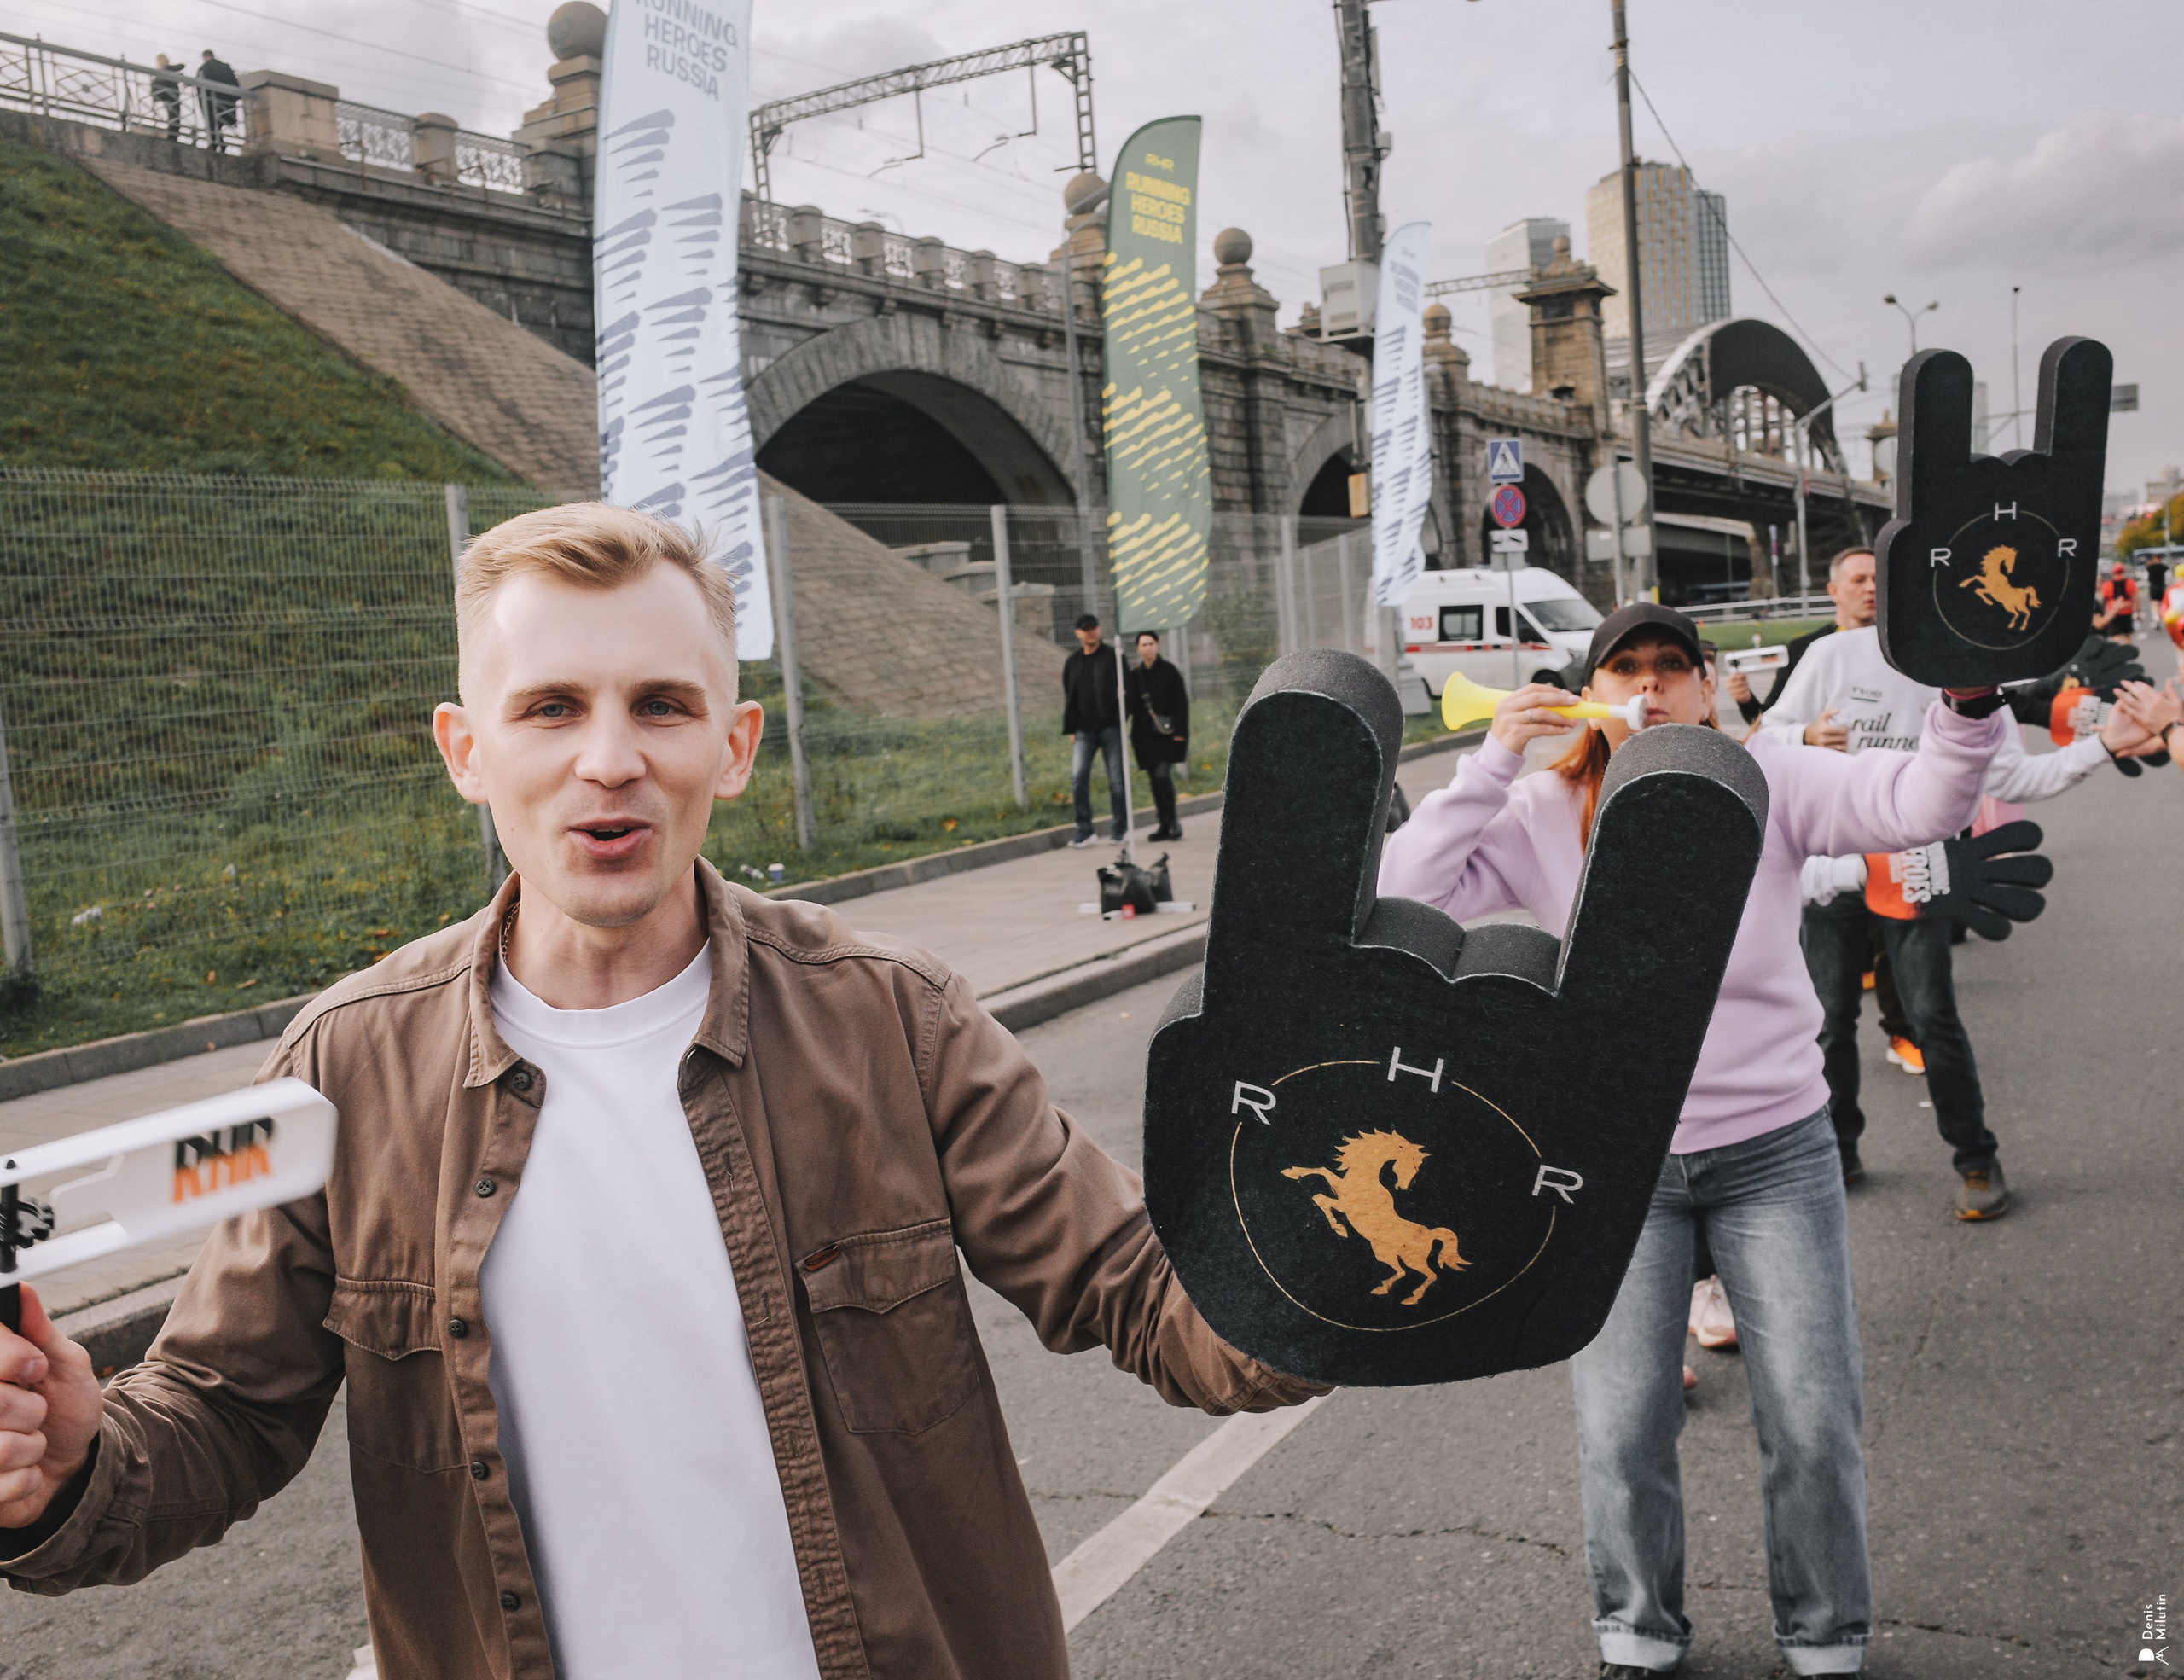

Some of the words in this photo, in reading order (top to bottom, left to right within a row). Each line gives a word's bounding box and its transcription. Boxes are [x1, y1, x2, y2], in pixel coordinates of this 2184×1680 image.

[636, 0, 739, 49] UNNING
[645, 14, 727, 73] HEROES
[647, 44, 719, 102] RUSSIA
[1130, 193, 1185, 224] HEROES
[1132, 213, 1183, 244] RUSSIA
[1930, 547, 1952, 567] R
[1994, 501, 2017, 521] H
[2058, 538, 2077, 557] R
[1410, 616, 1433, 630] 103
[1851, 712, 1891, 732] rail
[1857, 735, 1920, 749] runne
[1231, 1080, 1277, 1126] R
[1387, 1046, 1444, 1093] H
[1531, 1164, 1584, 1204] R
